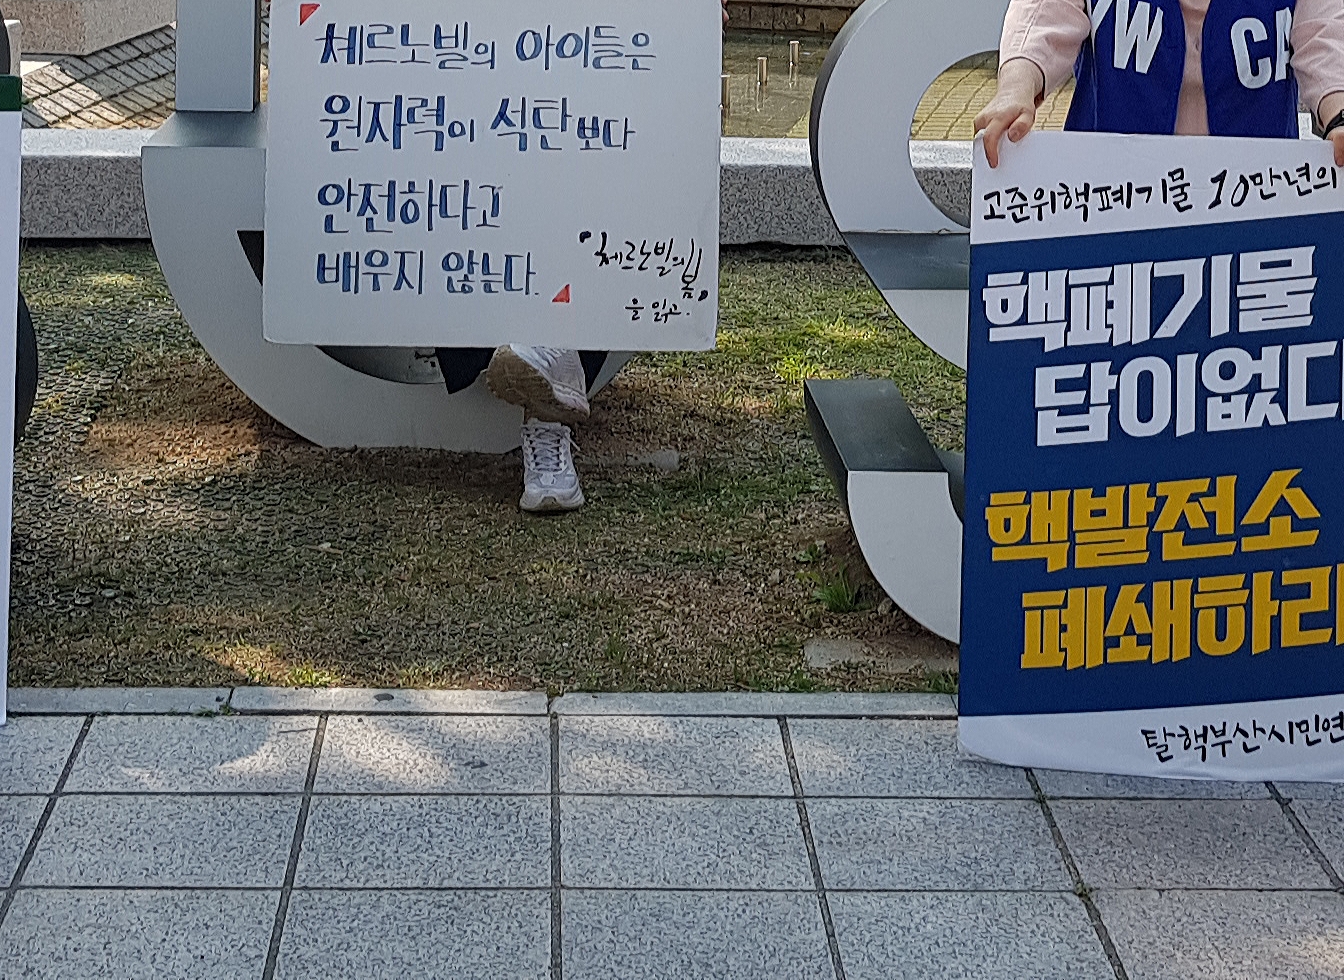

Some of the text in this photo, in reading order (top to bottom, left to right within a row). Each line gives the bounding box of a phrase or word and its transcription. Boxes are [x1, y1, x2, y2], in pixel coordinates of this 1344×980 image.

[315, 21, 657, 71] 체르노빌의 아이들은
[319, 94, 476, 152] 원자력이
[317, 178, 502, 234] 안전하다고
[982, 167, 1193, 223] 고준위핵폐기물
[1207, 162, 1338, 210] 10만년의
[316, 250, 424, 295] 배우지
[982, 245, 1318, 353] 핵폐기물
[984, 468, 1322, 573] 핵발전소
